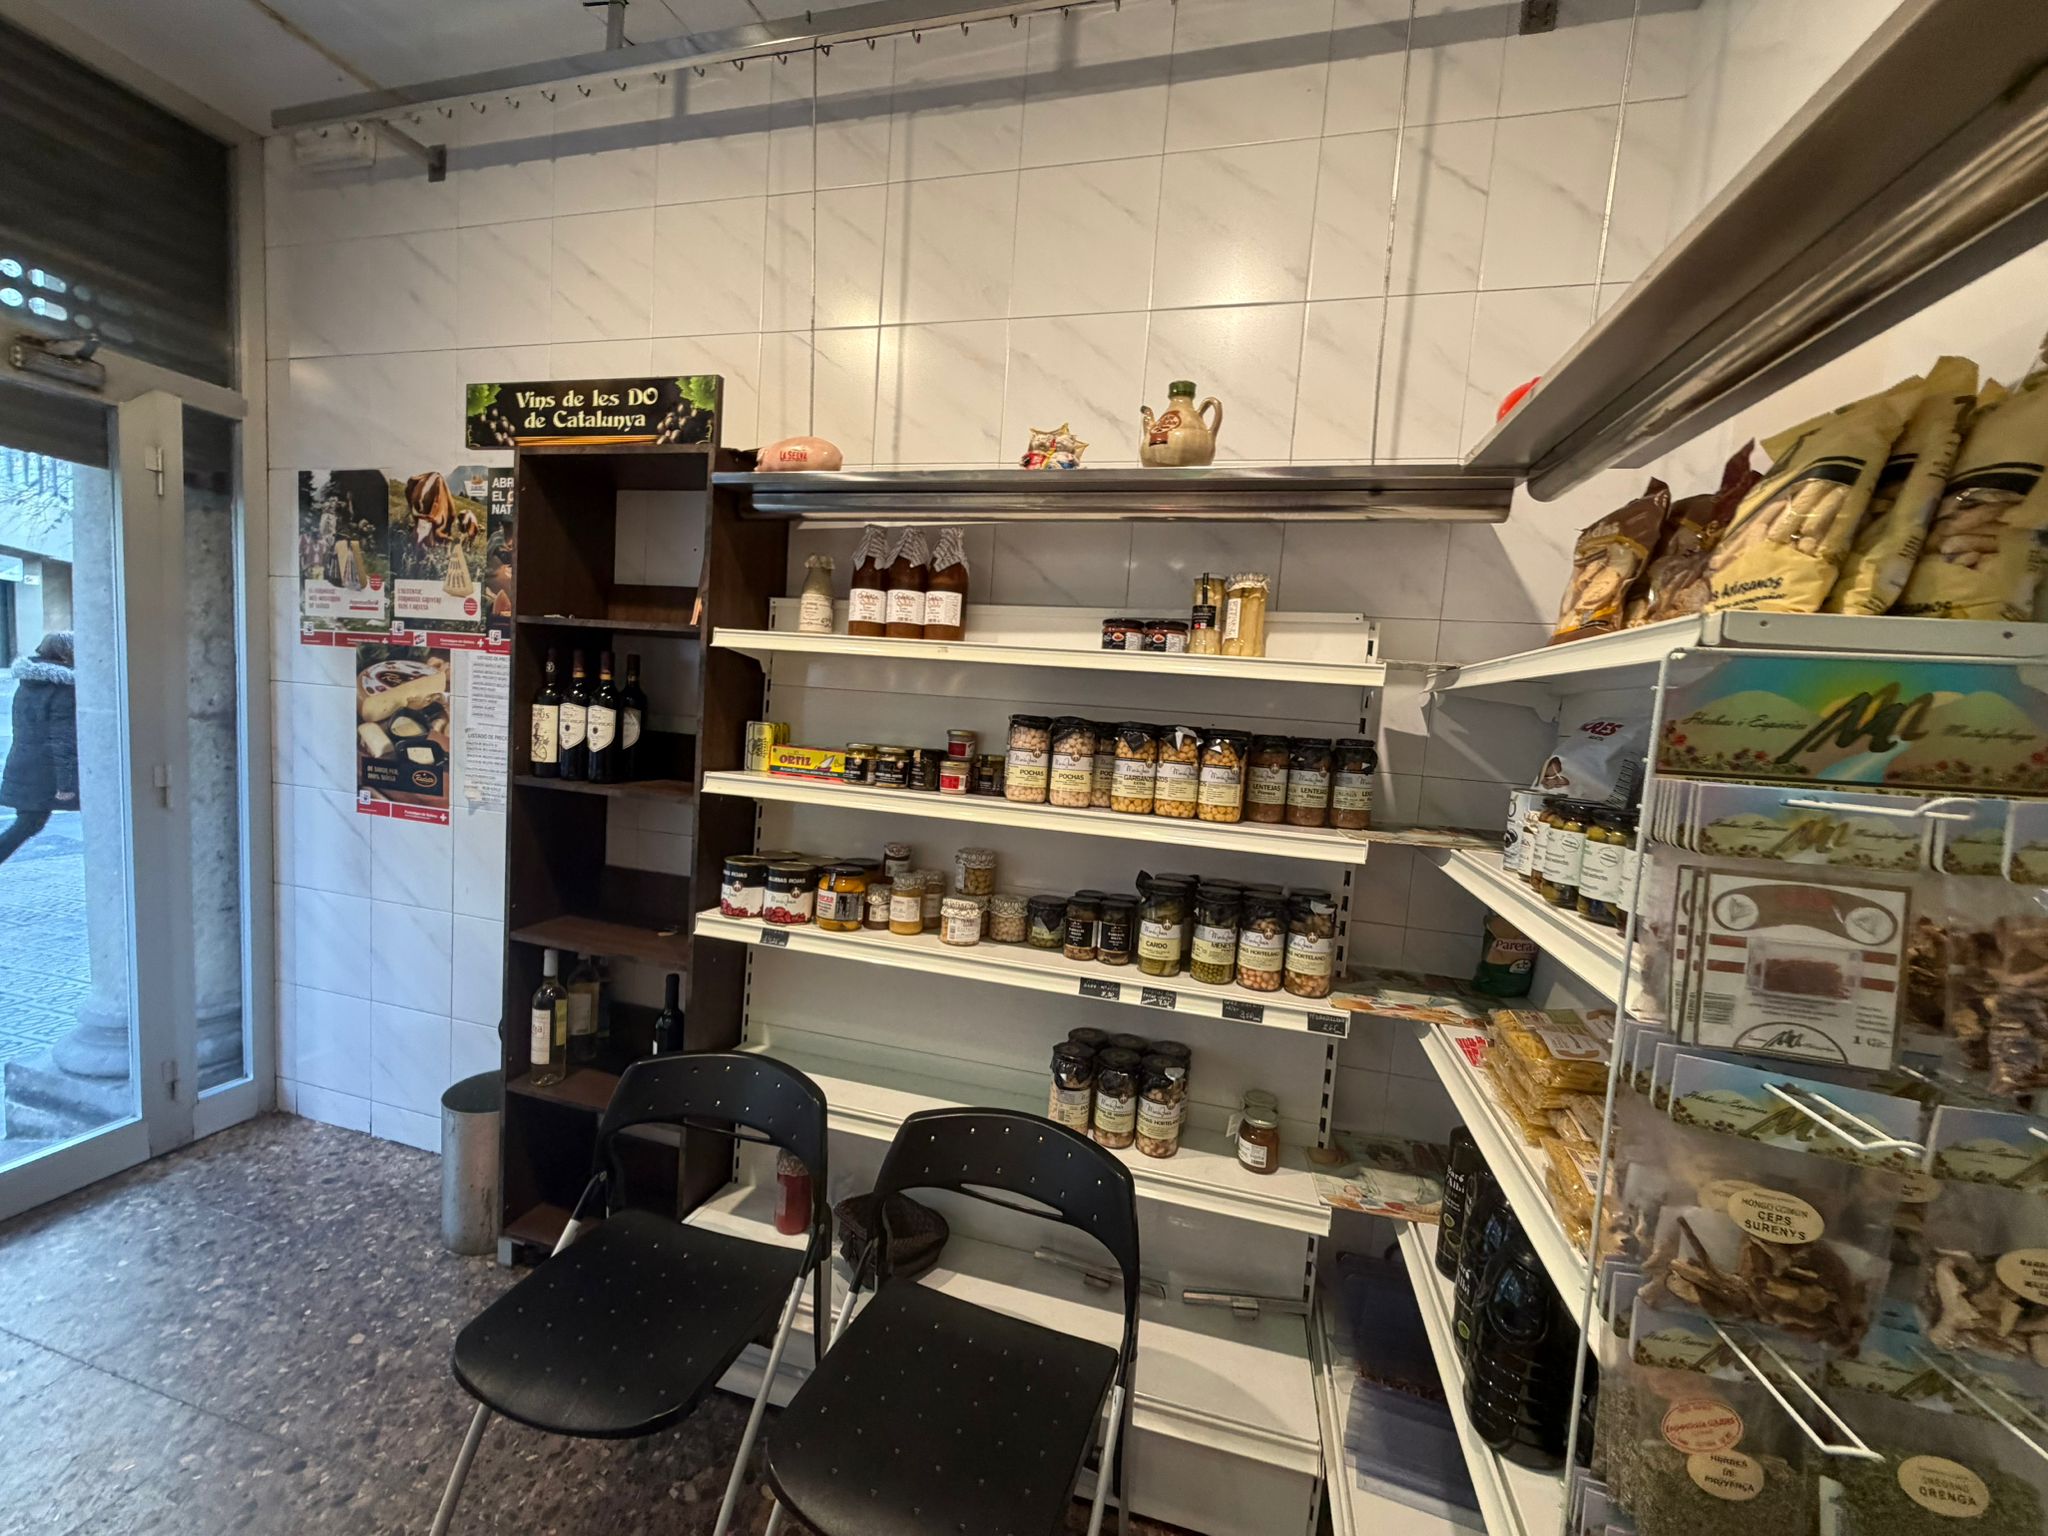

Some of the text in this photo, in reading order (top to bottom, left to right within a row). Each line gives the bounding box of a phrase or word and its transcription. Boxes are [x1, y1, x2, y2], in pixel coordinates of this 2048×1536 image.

[516, 387, 659, 411] Vins de les DO
[524, 410, 647, 432] de Catalunya
[492, 491, 506, 502] EL
[779, 754, 812, 767] ORTIZ
[1019, 769, 1044, 777] POCHAS
[1058, 773, 1085, 781] POCHAS
[1252, 783, 1281, 792] LENTEJAS
[1145, 940, 1168, 949] CARDO
[1757, 1210, 1792, 1226] CEPS
[1744, 1218, 1806, 1241] SURENYS
